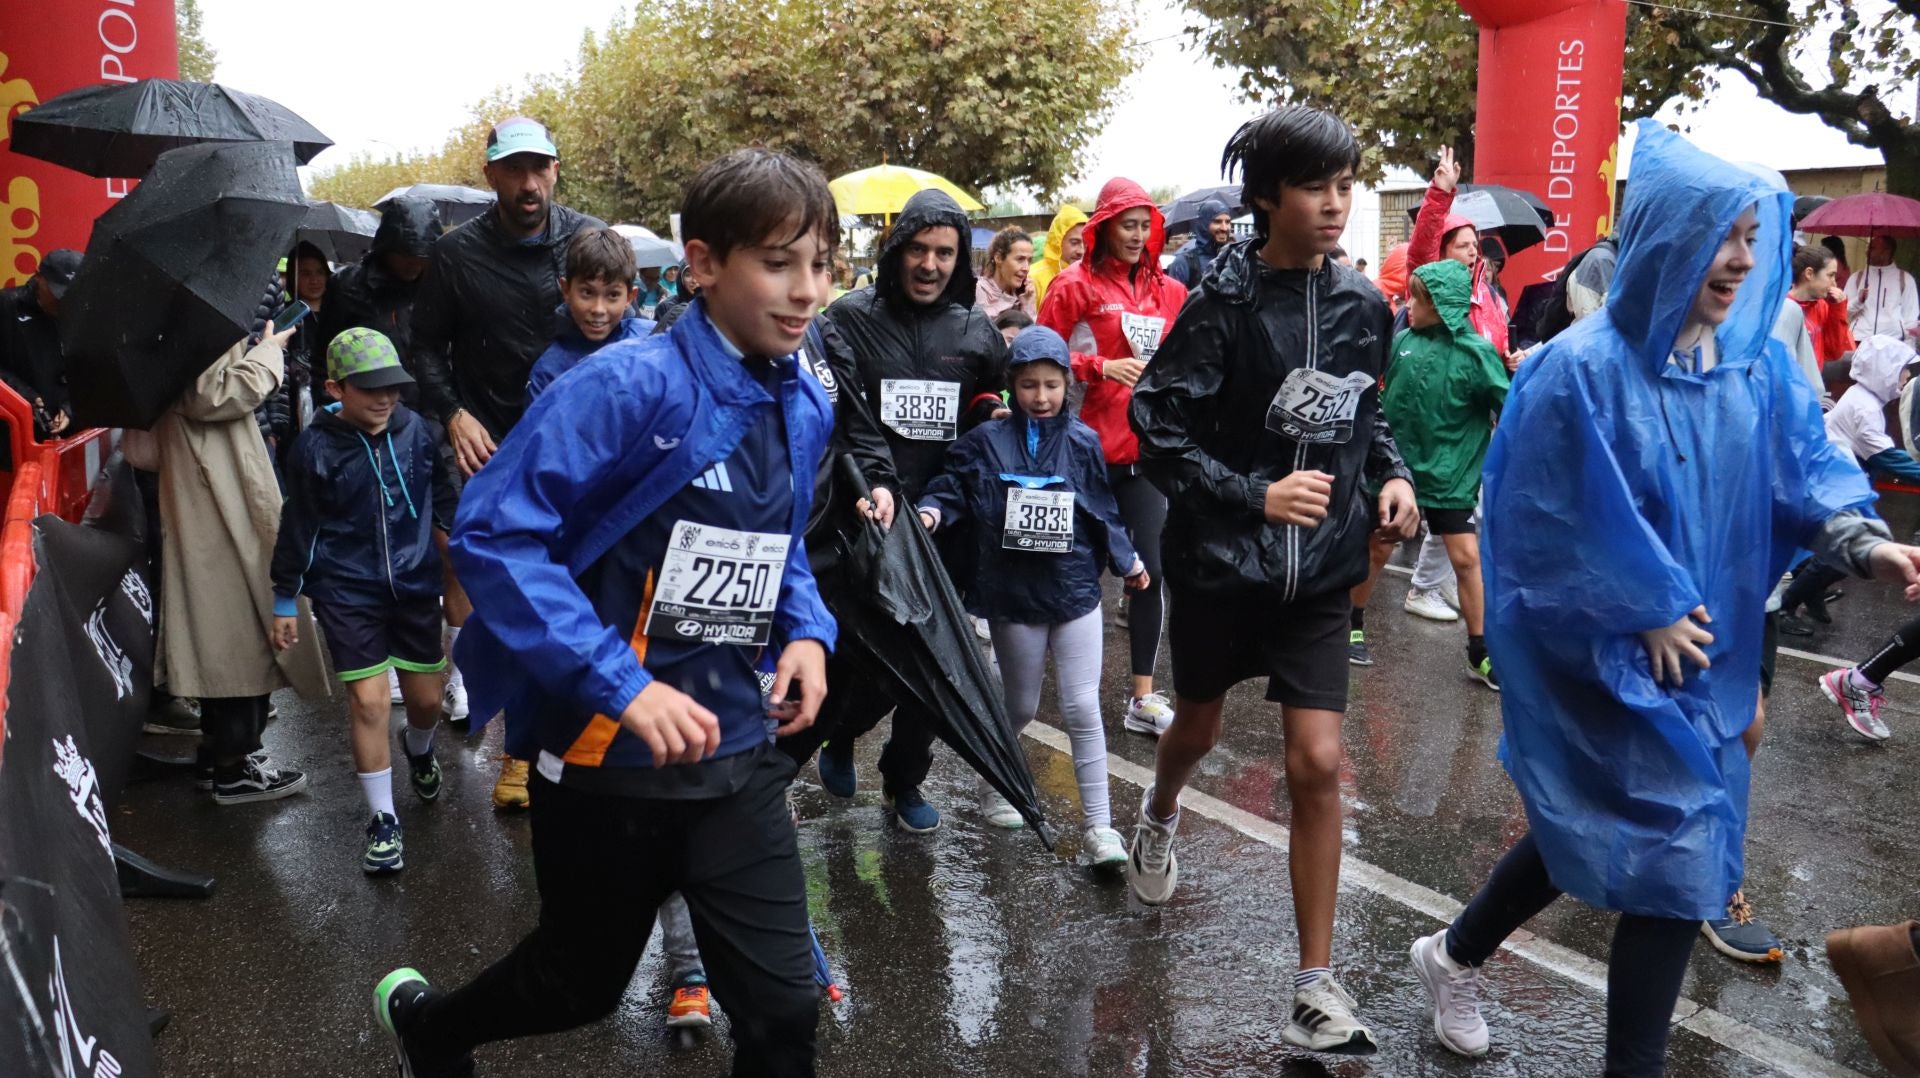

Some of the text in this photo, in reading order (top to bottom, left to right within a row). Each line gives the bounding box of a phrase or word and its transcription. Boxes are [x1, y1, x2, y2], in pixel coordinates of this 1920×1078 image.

[1548, 39, 1584, 199] DEPORTES
[1544, 213, 1571, 251] DE
[895, 395, 947, 420] 3836
[911, 428, 943, 436] HYUNDAI
[1019, 504, 1068, 532] 3839
[682, 556, 771, 609] 2250
[703, 623, 757, 638] HYUNDAI
